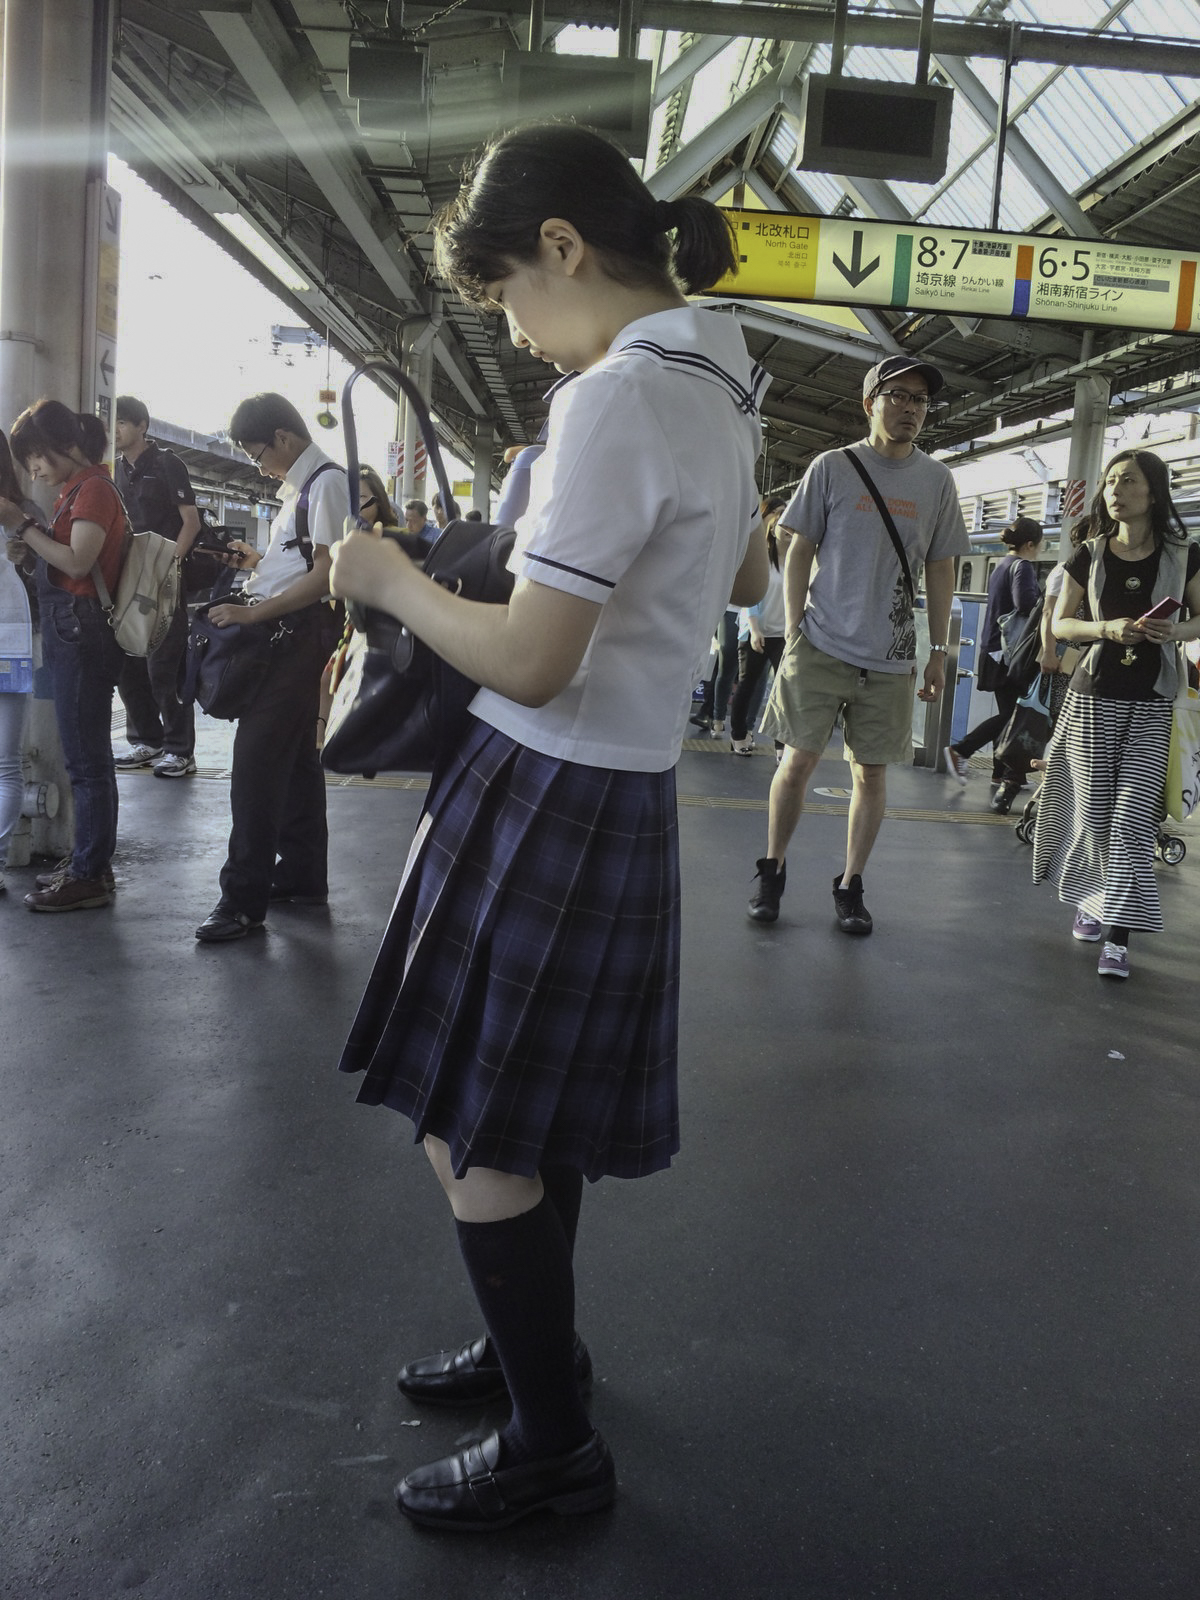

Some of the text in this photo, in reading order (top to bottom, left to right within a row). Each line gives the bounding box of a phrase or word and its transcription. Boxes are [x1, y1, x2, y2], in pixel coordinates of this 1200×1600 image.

[755, 223, 810, 239] 北改札口
[765, 239, 809, 251] North Gate
[916, 271, 1005, 288] 埼京線 りんかい線
[940, 289, 955, 298] Line
[1036, 282, 1124, 302] 湘南新宿ライン
[1101, 305, 1118, 313] Line
